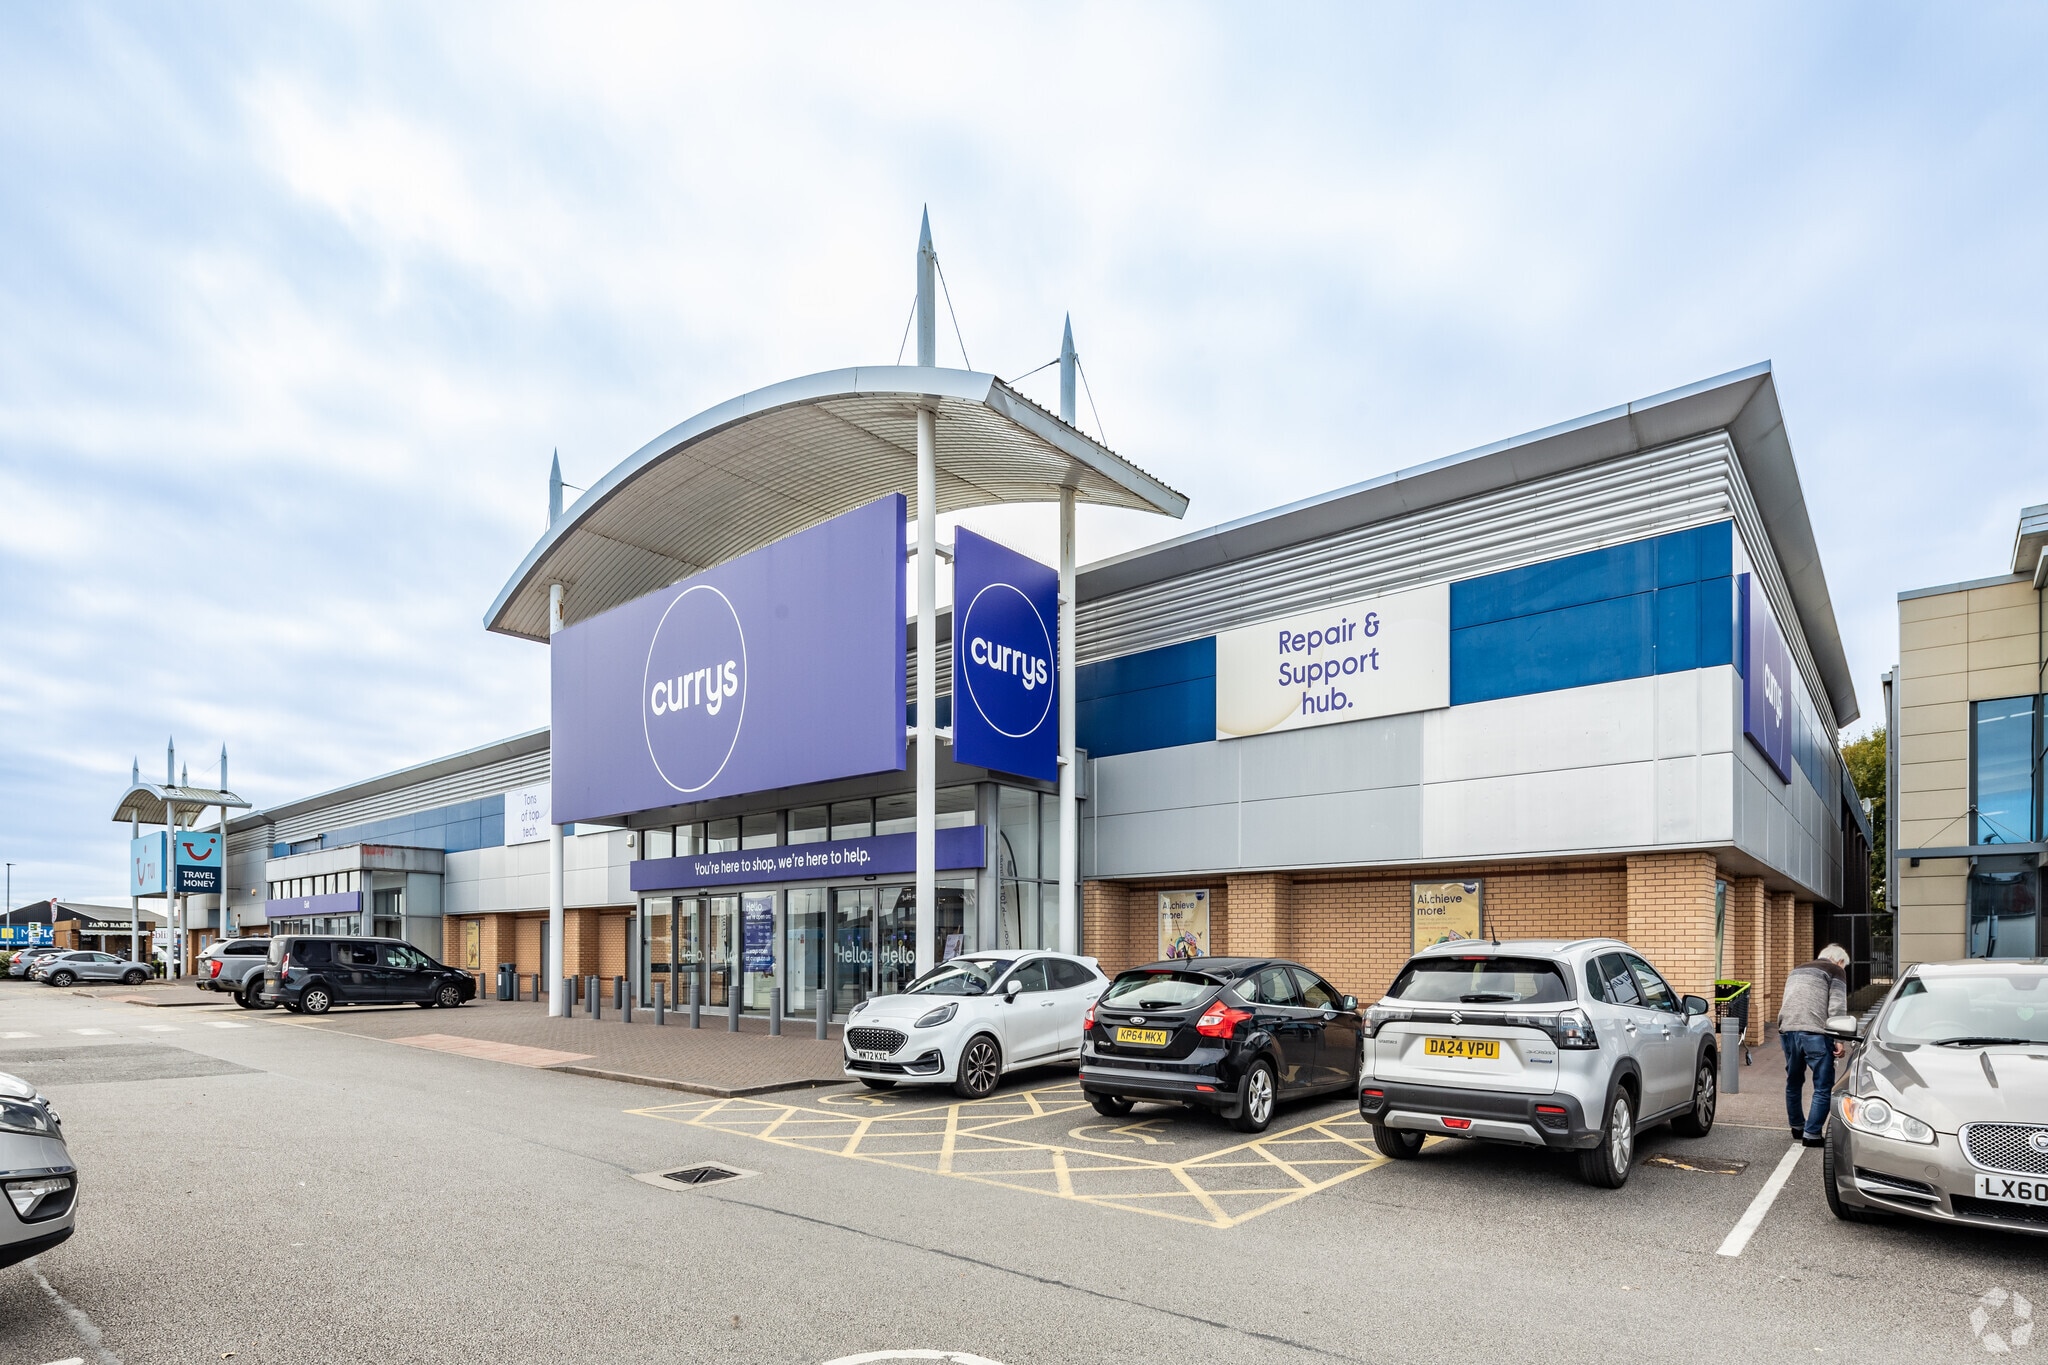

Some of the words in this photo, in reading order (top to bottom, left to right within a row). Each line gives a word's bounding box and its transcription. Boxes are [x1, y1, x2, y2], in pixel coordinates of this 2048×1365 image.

[1278, 617, 1357, 656] Repair
[1364, 611, 1380, 638] &
[971, 637, 1048, 691] currys
[1278, 647, 1380, 689] Support
[651, 660, 738, 716] currys
[1764, 663, 1782, 729] currys
[1302, 686, 1354, 716] hub.
[524, 794, 537, 806] Tons
[521, 810, 528, 822] of
[529, 810, 539, 822] top
[523, 826, 537, 838] tech.
[694, 861, 720, 876] You're
[720, 861, 739, 874] here
[741, 859, 751, 872] to
[752, 857, 777, 874] shop,
[778, 853, 804, 869] we're
[806, 851, 829, 867] here
[830, 850, 842, 865] to
[843, 847, 871, 866] help.
[182, 870, 216, 880] TRAVEL
[183, 880, 215, 888] MONEY
[1417, 905, 1446, 916] more!
[837, 945, 871, 964] Hello.
[1120, 1030, 1143, 1041] KP64
[1145, 1031, 1163, 1042] MKX
[874, 1052, 887, 1061] KXC
[1430, 1039, 1464, 1055] DA24
[1467, 1041, 1494, 1057] VPU
[1985, 1177, 2048, 1202] LX60
